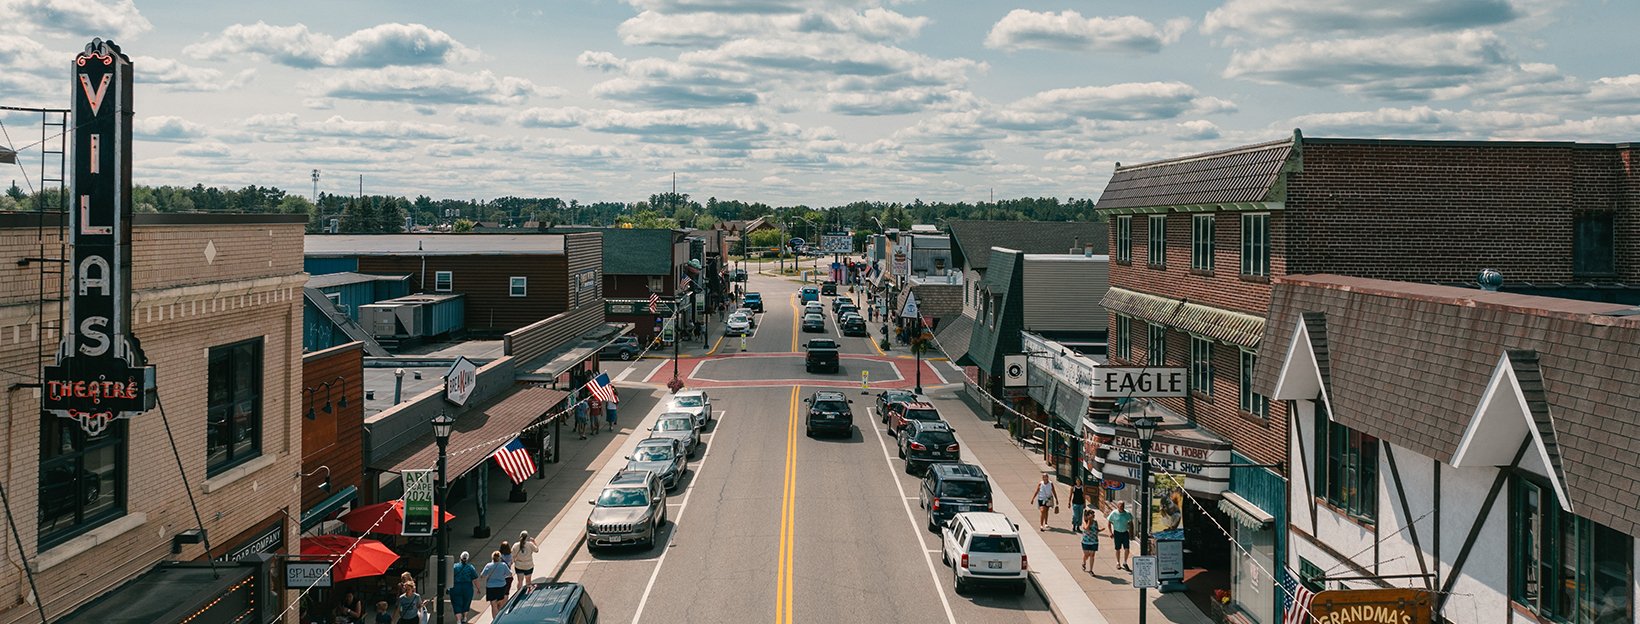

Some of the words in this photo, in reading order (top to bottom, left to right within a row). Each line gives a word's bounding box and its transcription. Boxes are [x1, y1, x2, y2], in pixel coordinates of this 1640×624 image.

[78, 73, 113, 357] VILAS
[47, 379, 138, 402] THEATRE
[1105, 372, 1182, 393] EAGLE
[1115, 436, 1141, 449] EAGLE
[1150, 442, 1170, 454] RAFT
[1173, 445, 1180, 455] &
[1181, 446, 1209, 460] HOBBY
[1118, 451, 1142, 464] SENIO
[1151, 457, 1177, 470] CRAFT
[1180, 461, 1202, 475] SHOP
[406, 472, 431, 482] ART
[406, 483, 432, 491] SCAPE
[407, 490, 432, 501] 2024
[250, 529, 281, 554] COMPANY
[1320, 605, 1412, 624] GRANDMA'S
